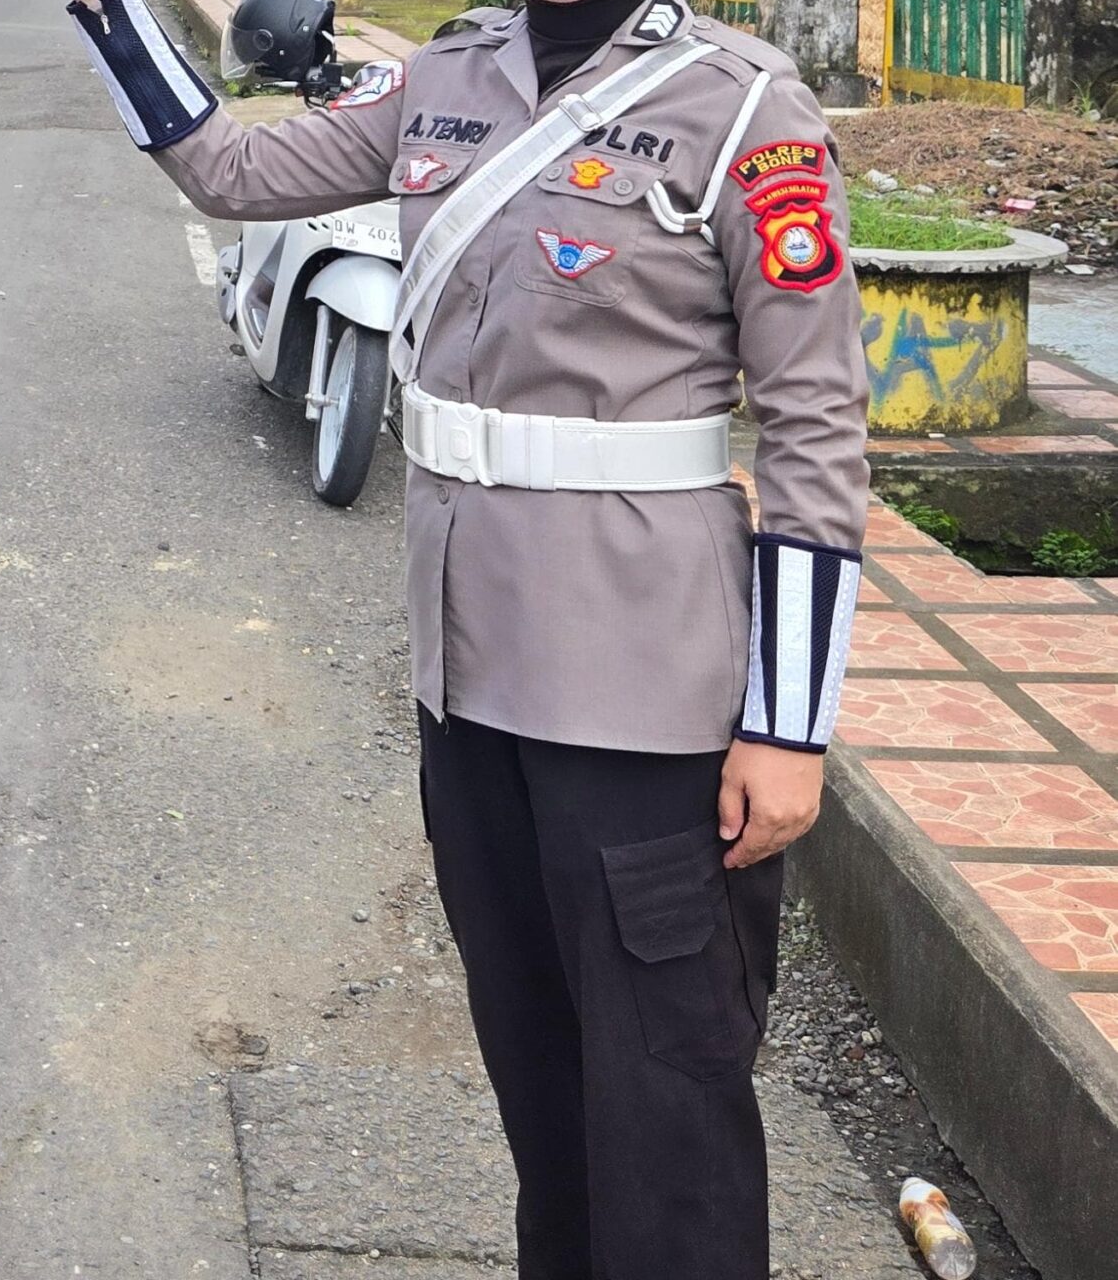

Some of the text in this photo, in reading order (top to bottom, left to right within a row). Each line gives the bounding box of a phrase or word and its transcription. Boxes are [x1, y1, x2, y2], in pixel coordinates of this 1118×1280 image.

[583, 124, 675, 163] OLRI
[739, 145, 817, 175] POLRES
[756, 154, 803, 174] BONE
